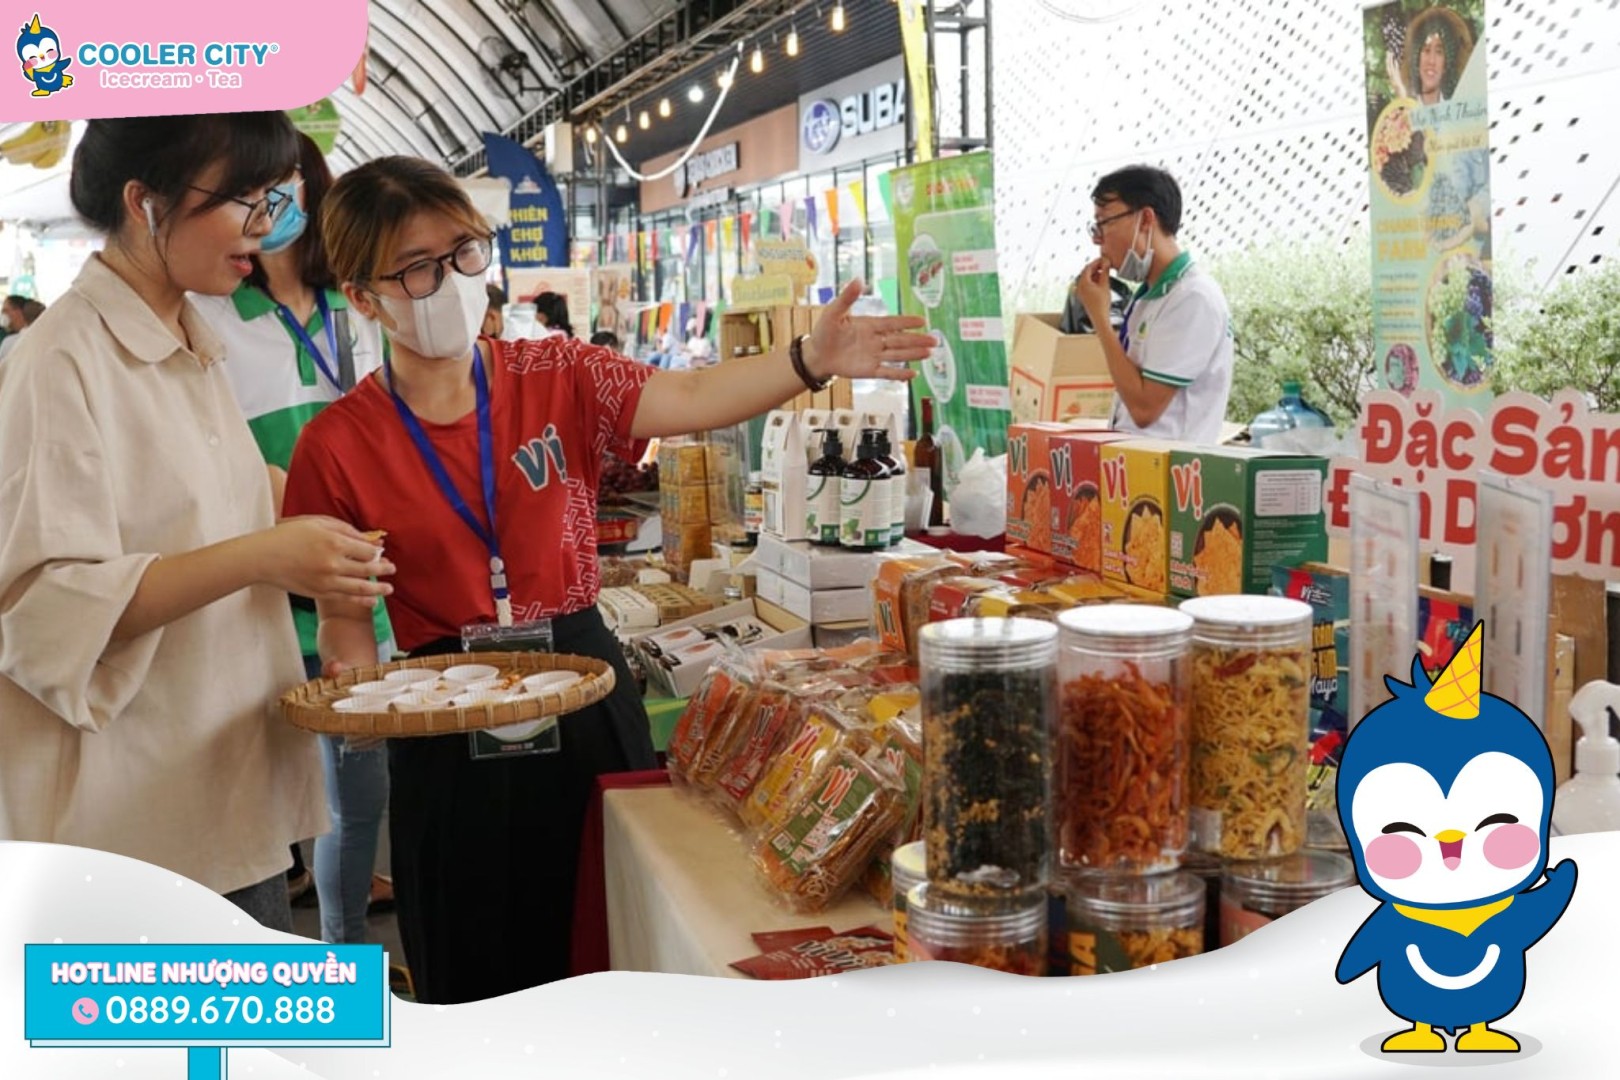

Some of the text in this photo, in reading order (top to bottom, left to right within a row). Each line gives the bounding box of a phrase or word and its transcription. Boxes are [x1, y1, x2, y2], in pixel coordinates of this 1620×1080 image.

[511, 423, 567, 492] Vị
[1008, 434, 1028, 482] Vị
[1361, 401, 1620, 484] Đặc Sản
[1051, 444, 1073, 497] Vị
[1102, 454, 1129, 509] Vị
[1172, 459, 1203, 520] Vị
[1311, 676, 1338, 701] ayo
[817, 765, 858, 817] Vị
